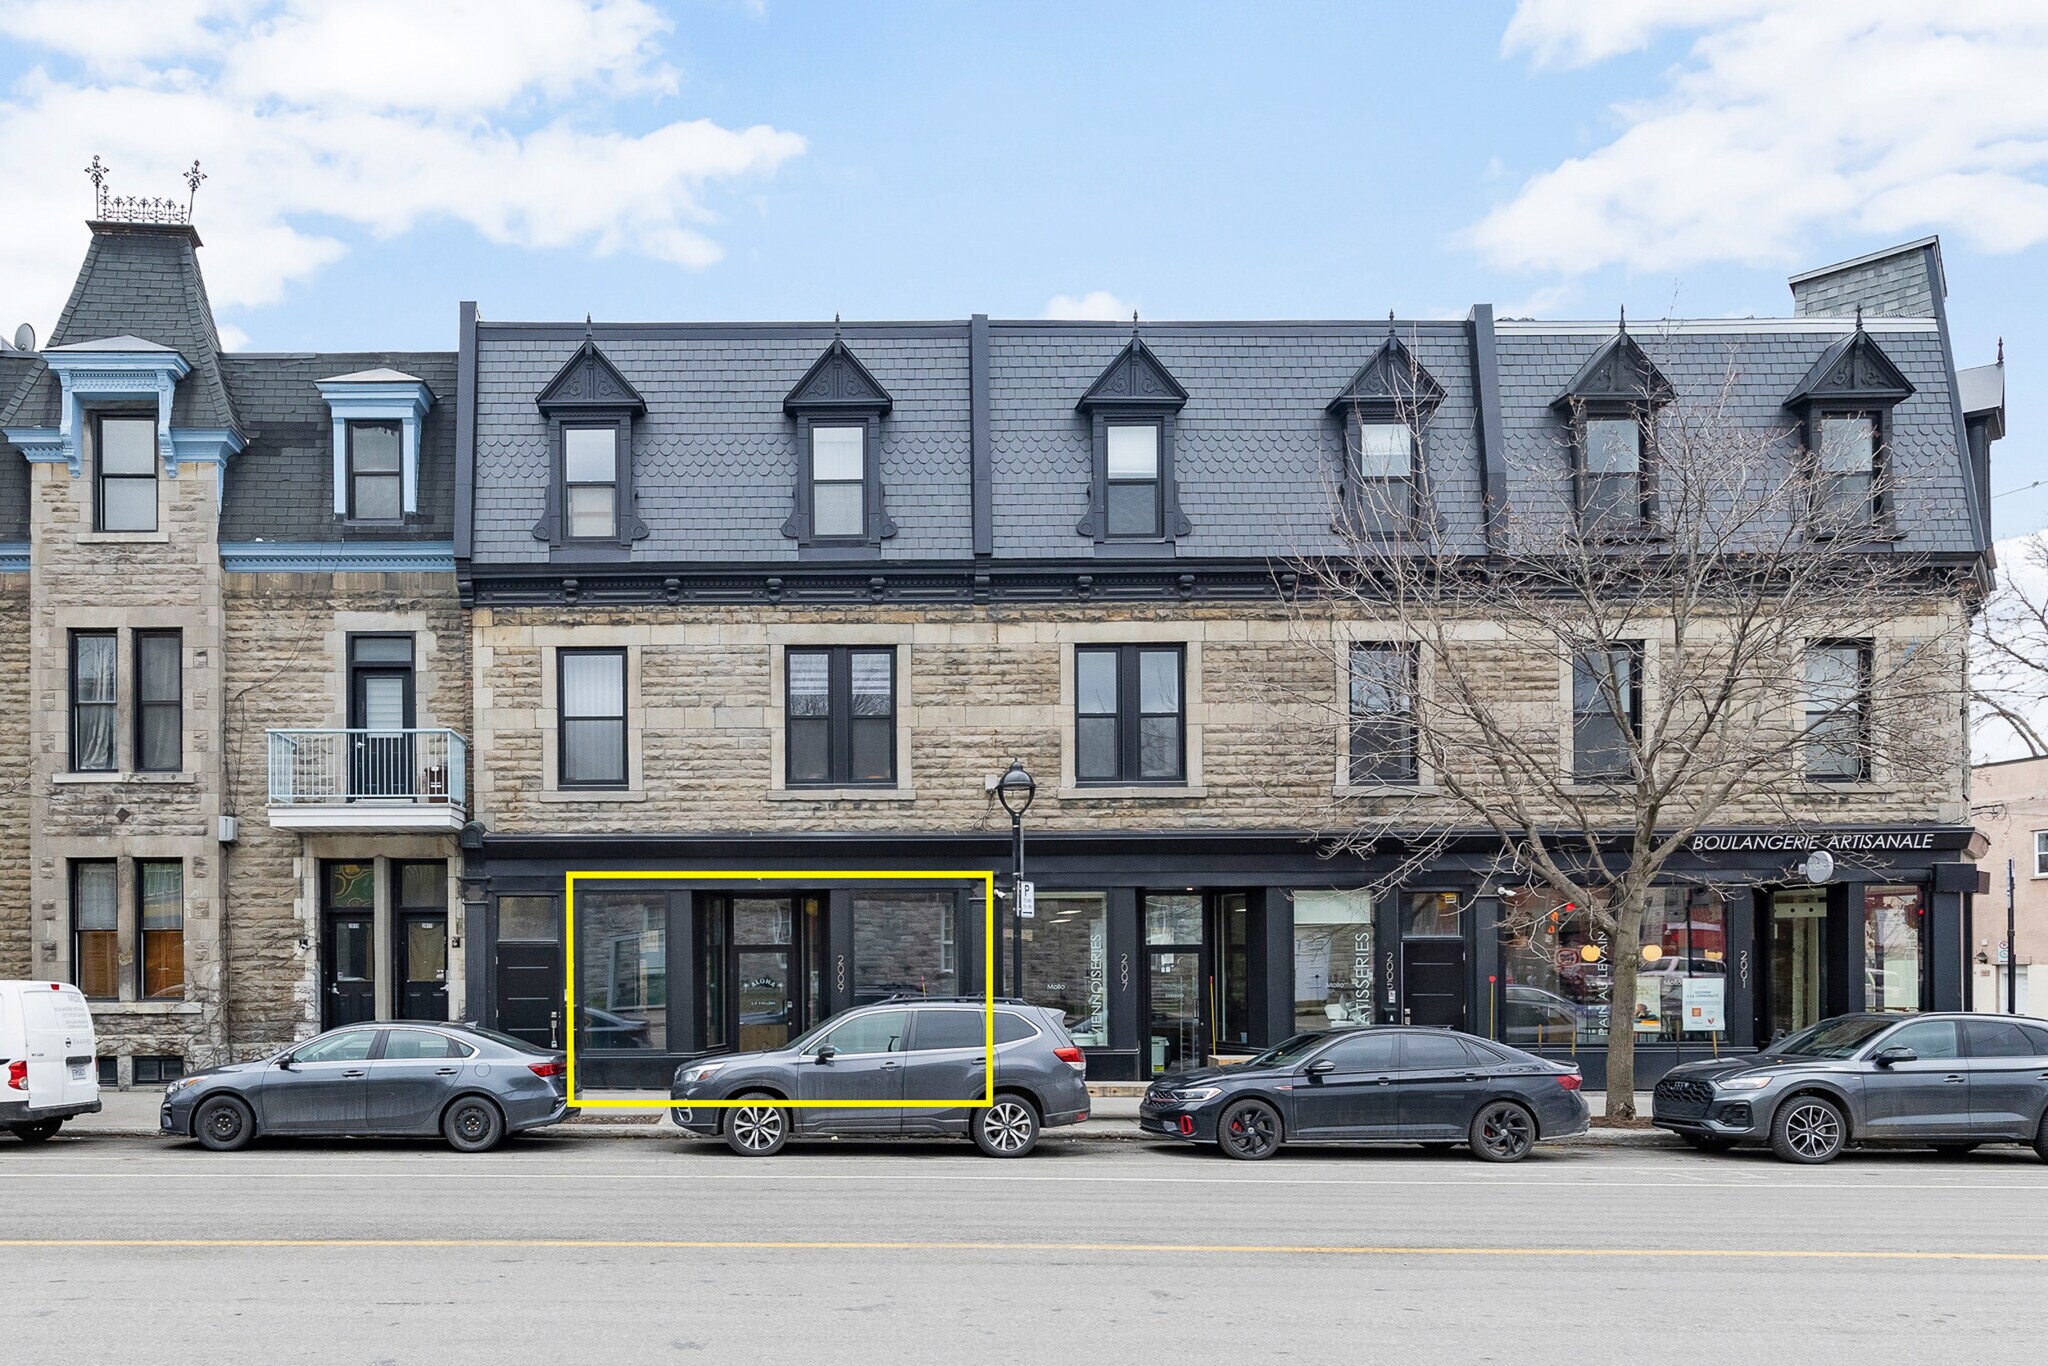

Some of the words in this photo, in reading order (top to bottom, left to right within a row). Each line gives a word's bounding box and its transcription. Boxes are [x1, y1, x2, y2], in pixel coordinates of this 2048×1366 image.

[1692, 835, 1820, 850] BOULANGERIE
[1826, 834, 1934, 849] ARTISANALE
[1024, 884, 1030, 897] P
[1120, 953, 1129, 992] 2007
[1386, 952, 1394, 990] 2005
[1597, 931, 1609, 977] LEVAIN
[1740, 950, 1748, 989] 2001
[750, 978, 776, 988] ALOHA
[837, 954, 845, 994] 2009
[1090, 934, 1103, 1036] VIENNOISERIES
[1355, 932, 1370, 1023] ATISSERIES
[1598, 981, 1609, 1001] AU
[1598, 1004, 1609, 1036] PAIN
